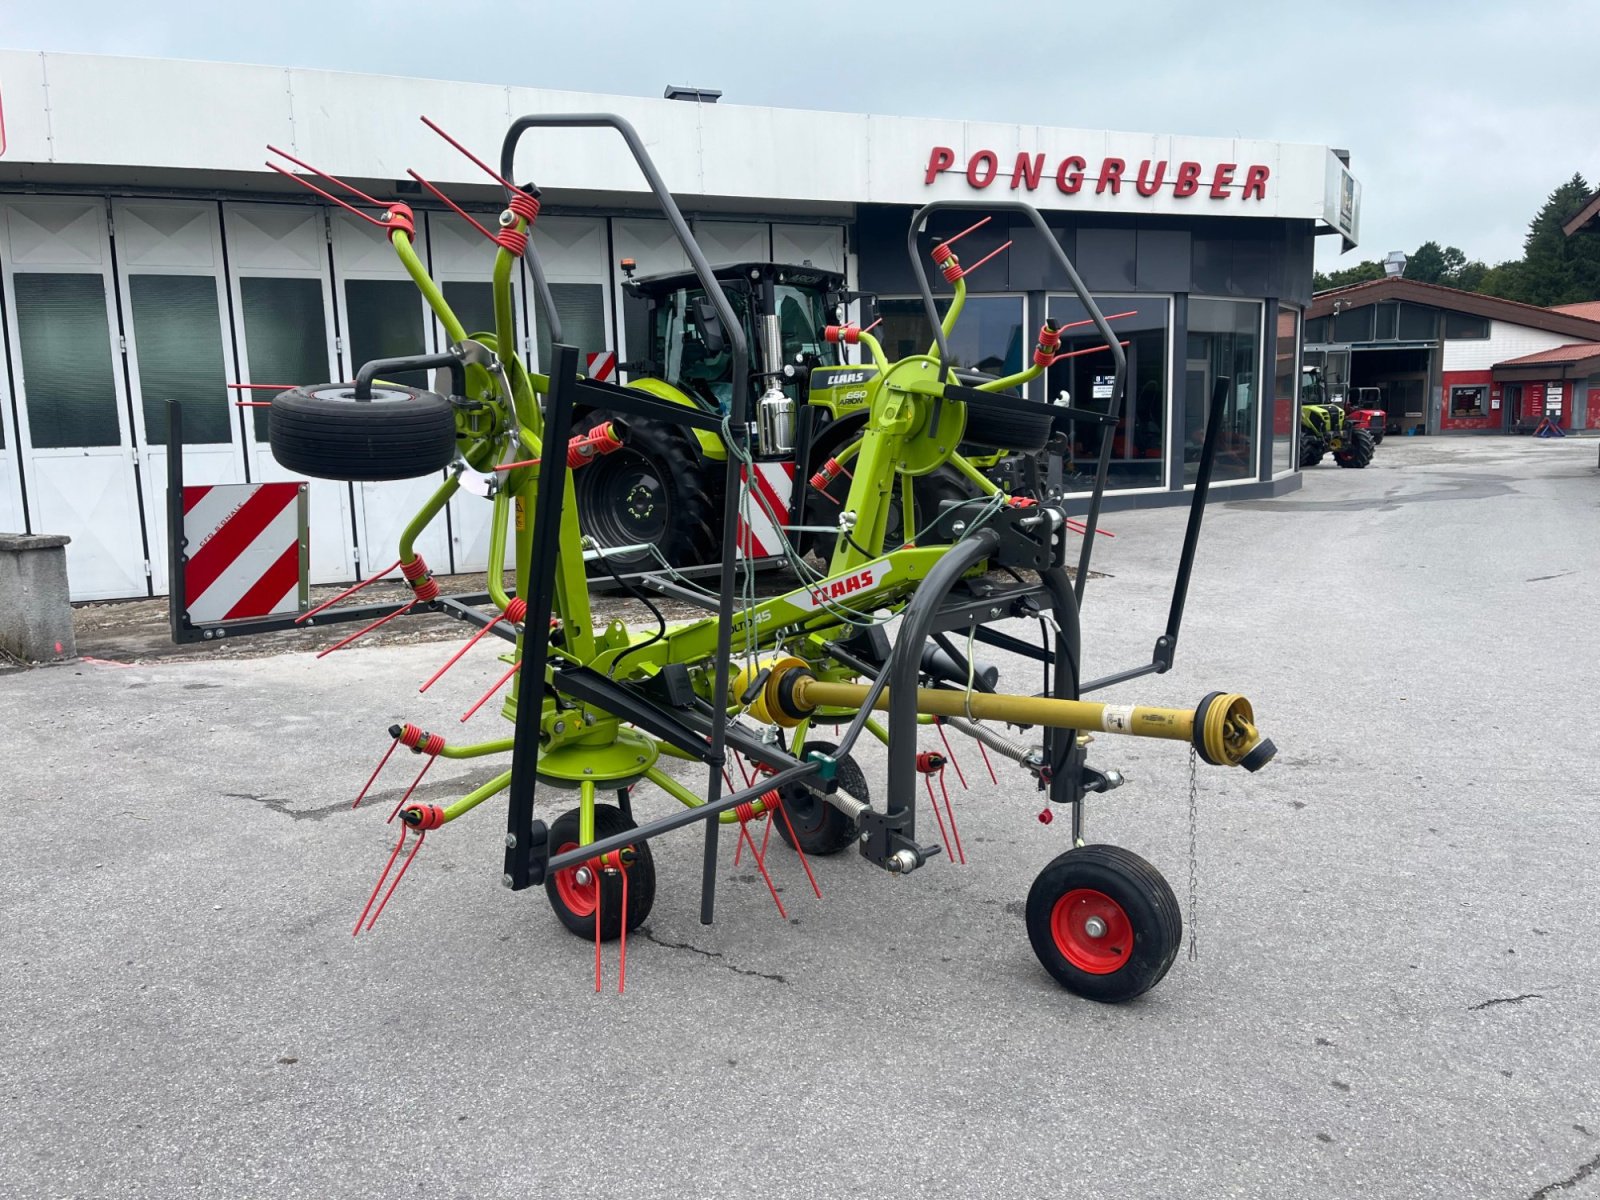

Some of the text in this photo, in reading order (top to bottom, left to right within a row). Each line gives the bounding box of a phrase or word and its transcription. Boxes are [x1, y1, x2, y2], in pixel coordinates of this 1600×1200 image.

[925, 147, 1270, 200] PONGRUBER
[828, 373, 864, 385] CLAAS
[846, 391, 868, 399] 660
[839, 398, 864, 406] ARION
[811, 570, 873, 606] CLAAS
[754, 609, 772, 624] 45
